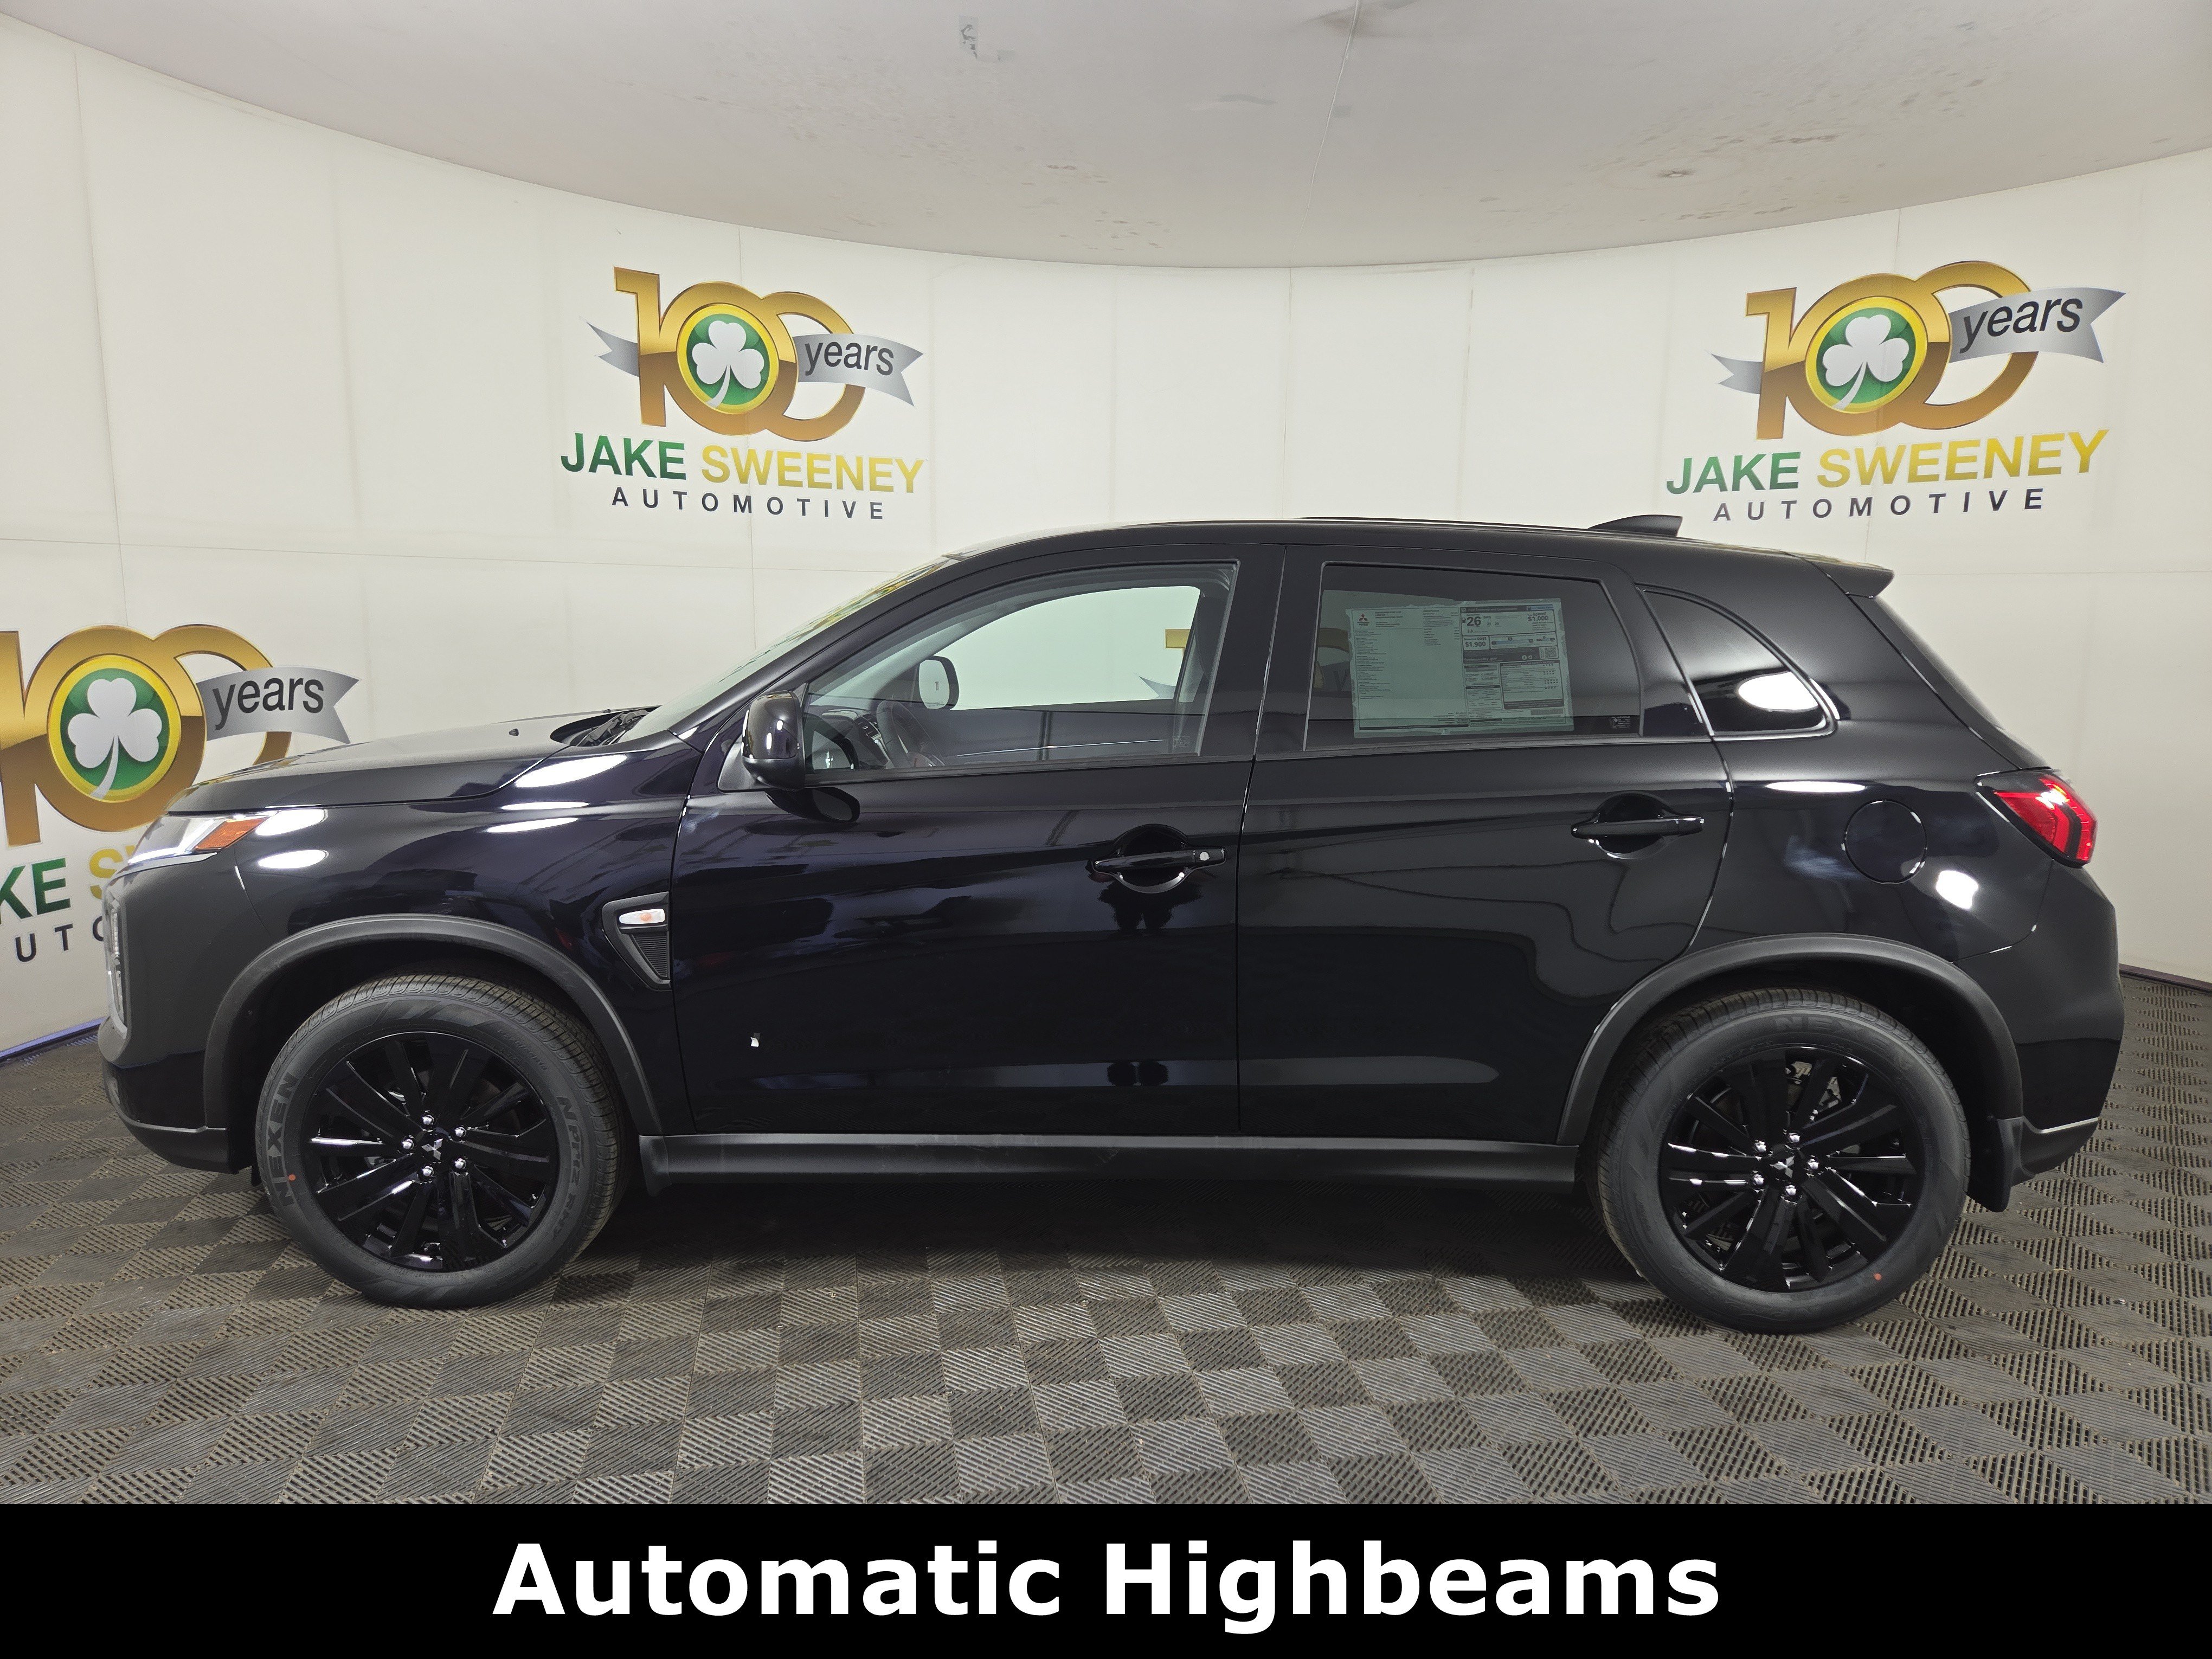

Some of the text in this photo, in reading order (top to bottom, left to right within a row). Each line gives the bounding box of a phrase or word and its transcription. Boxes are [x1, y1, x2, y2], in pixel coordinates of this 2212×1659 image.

[1959, 297, 2084, 354] years
[804, 342, 894, 376] years
[561, 433, 924, 493] JAKE SWEENEY
[1666, 429, 2109, 494] JAKE SWEENEY
[612, 487, 883, 520] AUTOMOTIVE
[1713, 488, 2044, 522] AUTOMOTIVE
[1467, 616, 1482, 626] 26
[213, 677, 324, 730] years
[267, 1072, 299, 1206] NEXEN
